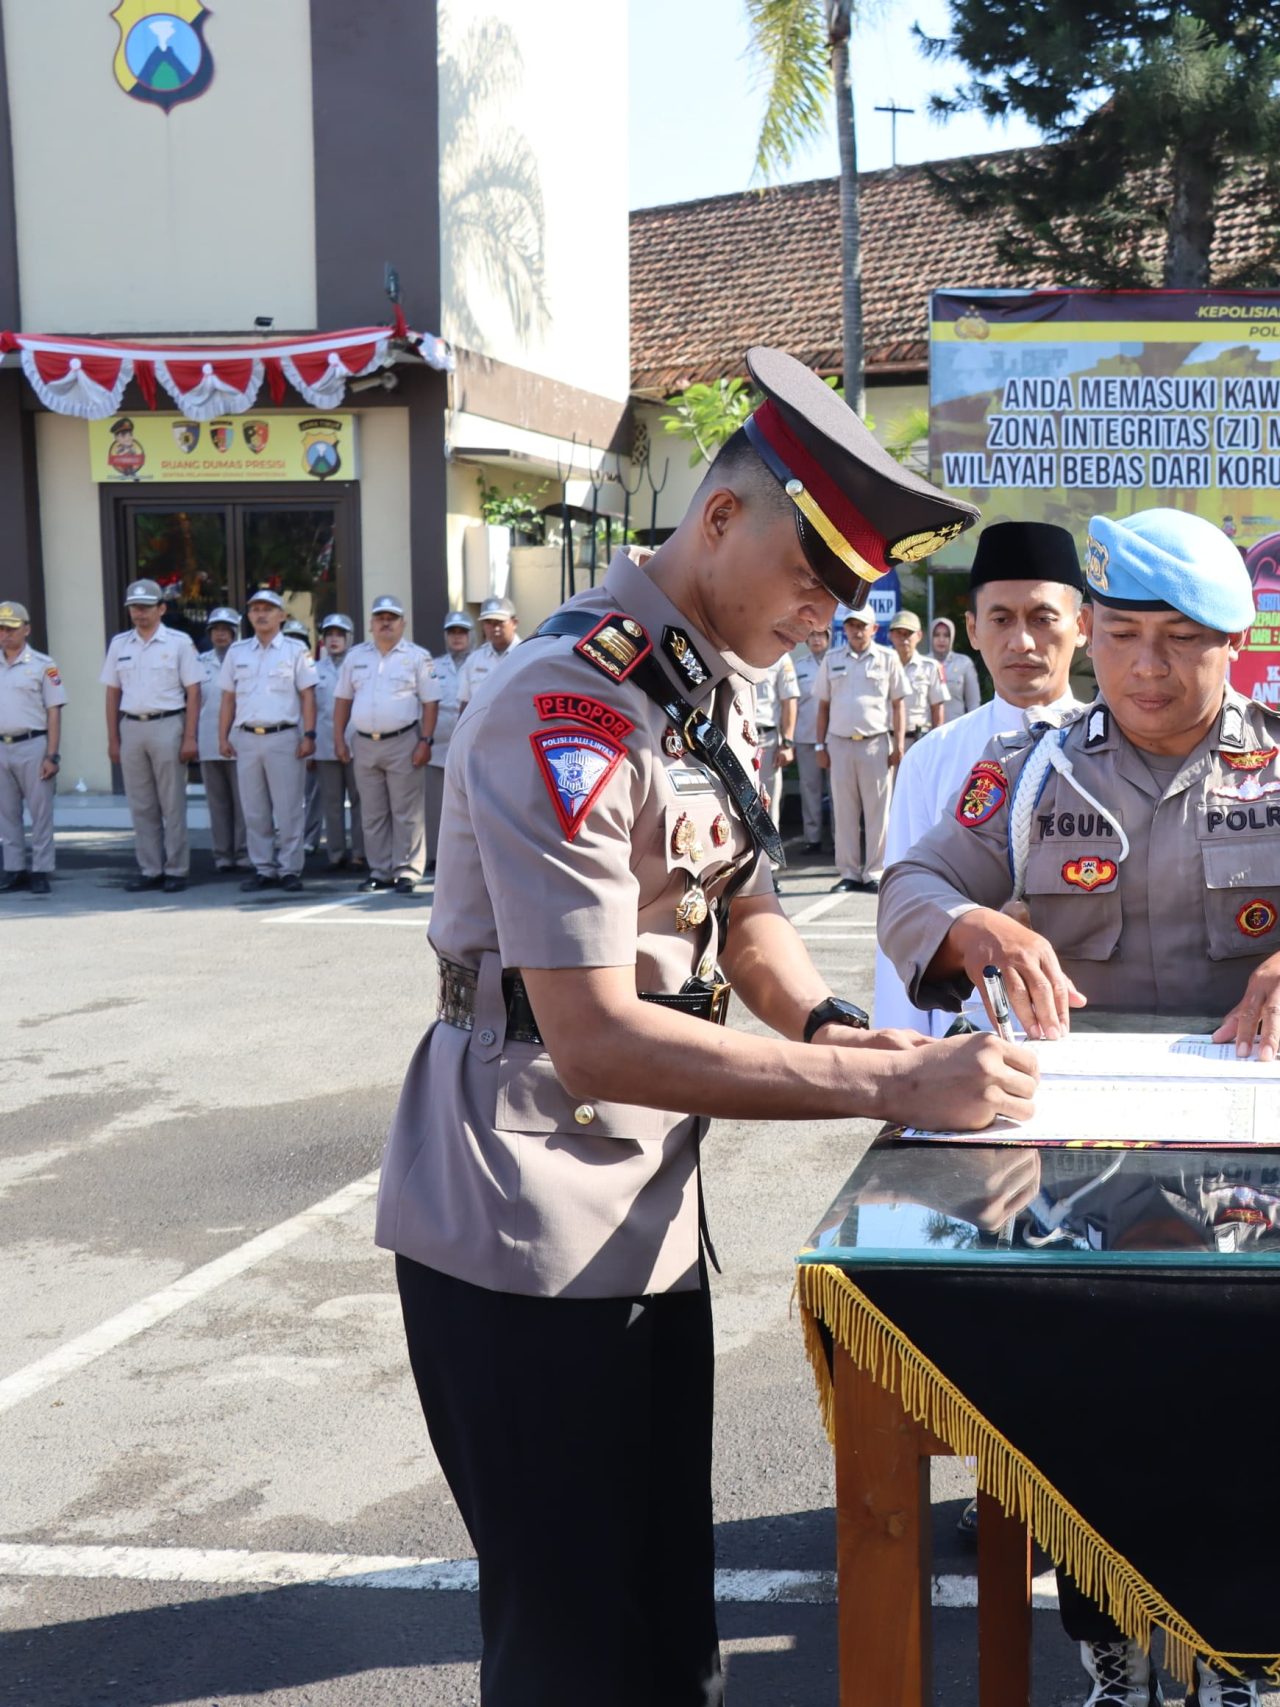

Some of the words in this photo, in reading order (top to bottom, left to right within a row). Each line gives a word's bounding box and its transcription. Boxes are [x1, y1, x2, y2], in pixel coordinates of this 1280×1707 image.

[1004, 378, 1073, 409] ANDA
[1081, 378, 1216, 409] MEMASUKI
[989, 416, 1055, 447] ZONA
[1063, 417, 1208, 448] INTEGRITAS
[1216, 416, 1260, 449] (ZI)
[160, 460, 200, 469] RUANG
[202, 460, 243, 469] DUMAS
[244, 460, 286, 469] PRESISI
[945, 454, 1054, 485] WILAYAH
[1062, 455, 1144, 486] BEBAS
[1152, 455, 1209, 486] DARI
[541, 697, 626, 739] PELOPOR
[1037, 812, 1114, 840] TEGUH
